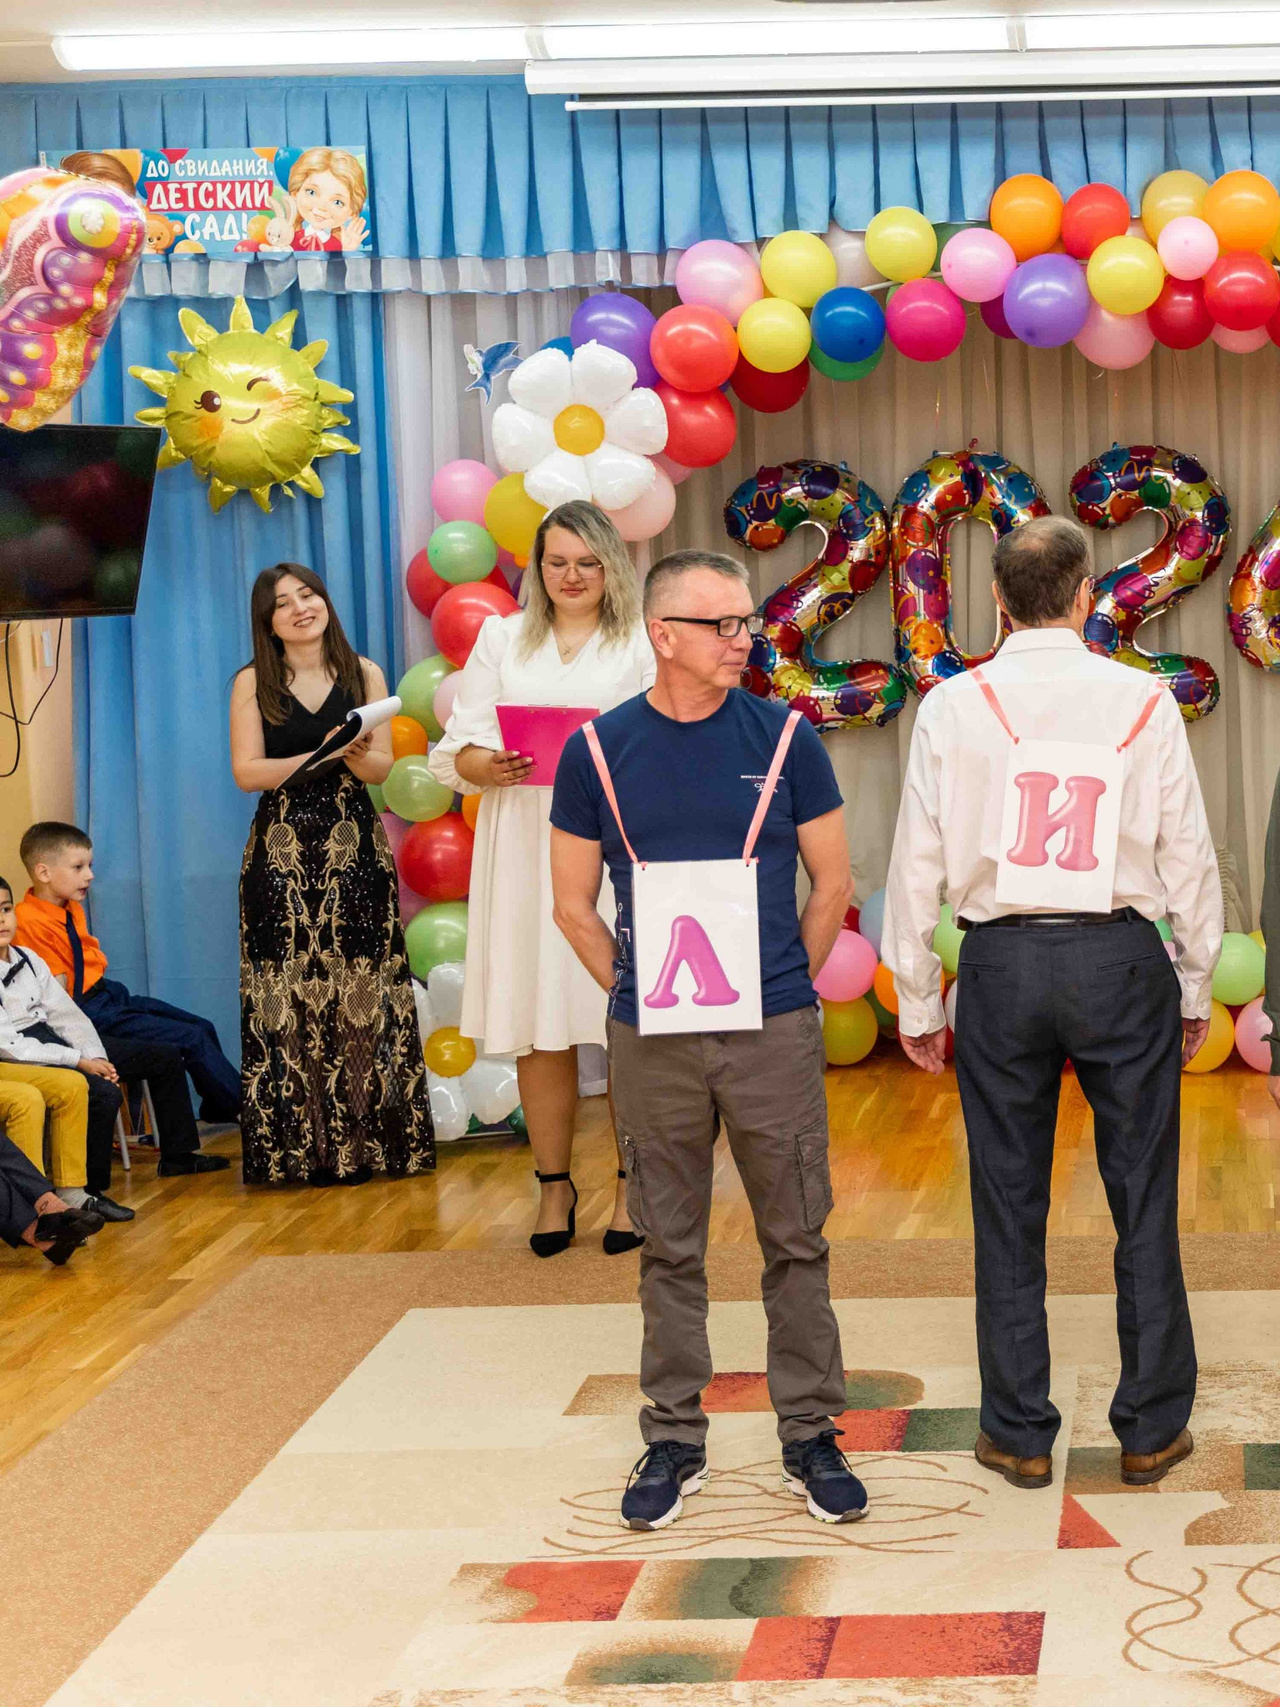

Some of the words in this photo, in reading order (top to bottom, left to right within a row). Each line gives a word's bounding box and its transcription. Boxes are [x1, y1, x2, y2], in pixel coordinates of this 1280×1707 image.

[146, 160, 169, 178] ДО
[149, 178, 270, 210] ДЕТСКИЙ
[184, 213, 248, 241] САД!
[1006, 771, 1107, 872] И
[643, 914, 741, 1009] Л
